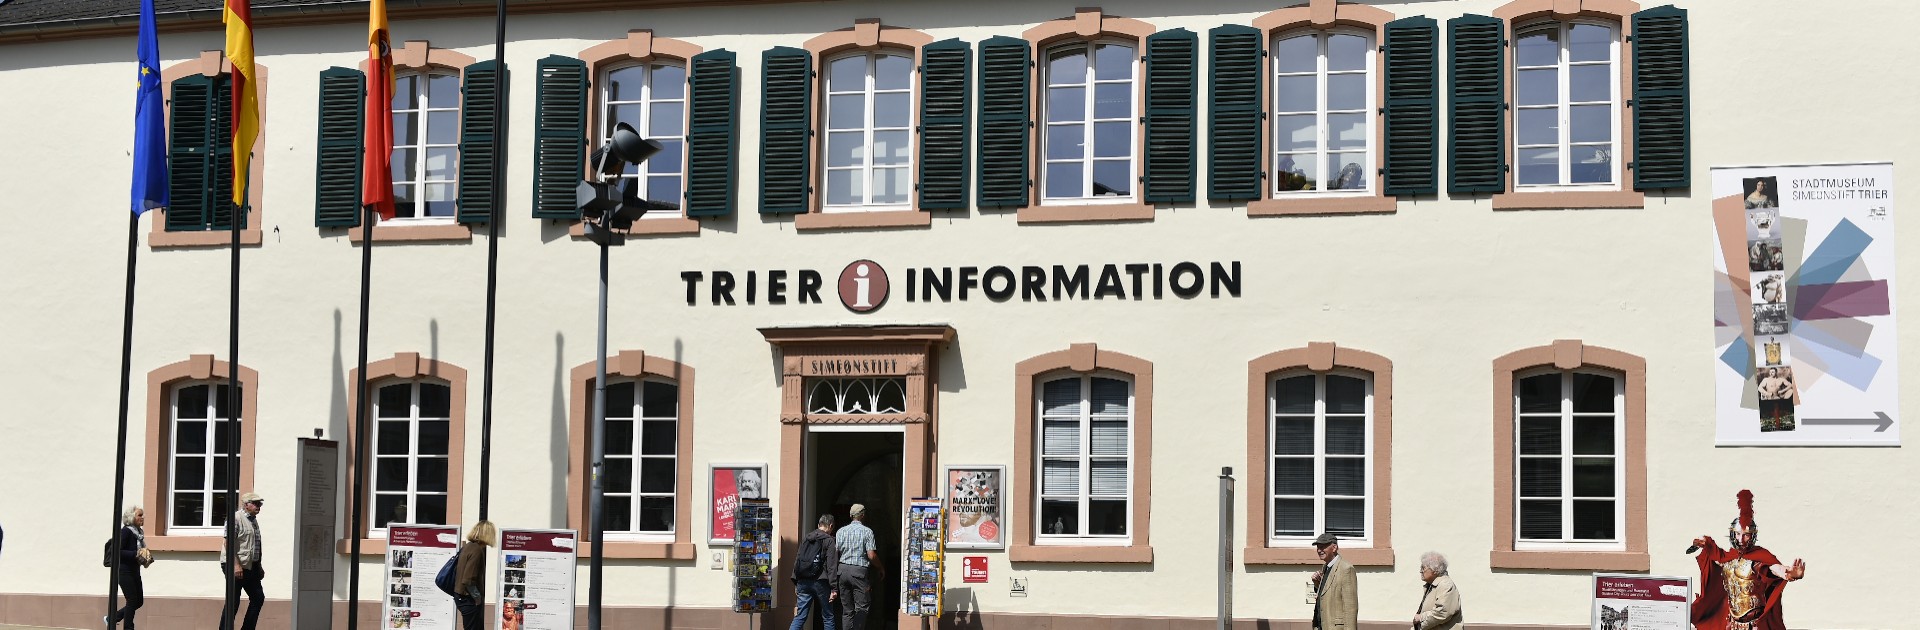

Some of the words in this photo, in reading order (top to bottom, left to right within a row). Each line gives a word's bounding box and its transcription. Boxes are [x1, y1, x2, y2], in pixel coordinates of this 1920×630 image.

[1792, 177, 1875, 188] STADTMUSEUM
[1792, 189, 1855, 200] SIMEONSTIFT
[1858, 189, 1888, 199] TRIER
[681, 269, 823, 306] TRIER
[906, 261, 1242, 303] INFORMATION
[811, 359, 898, 374] SIMEONSTIFT
